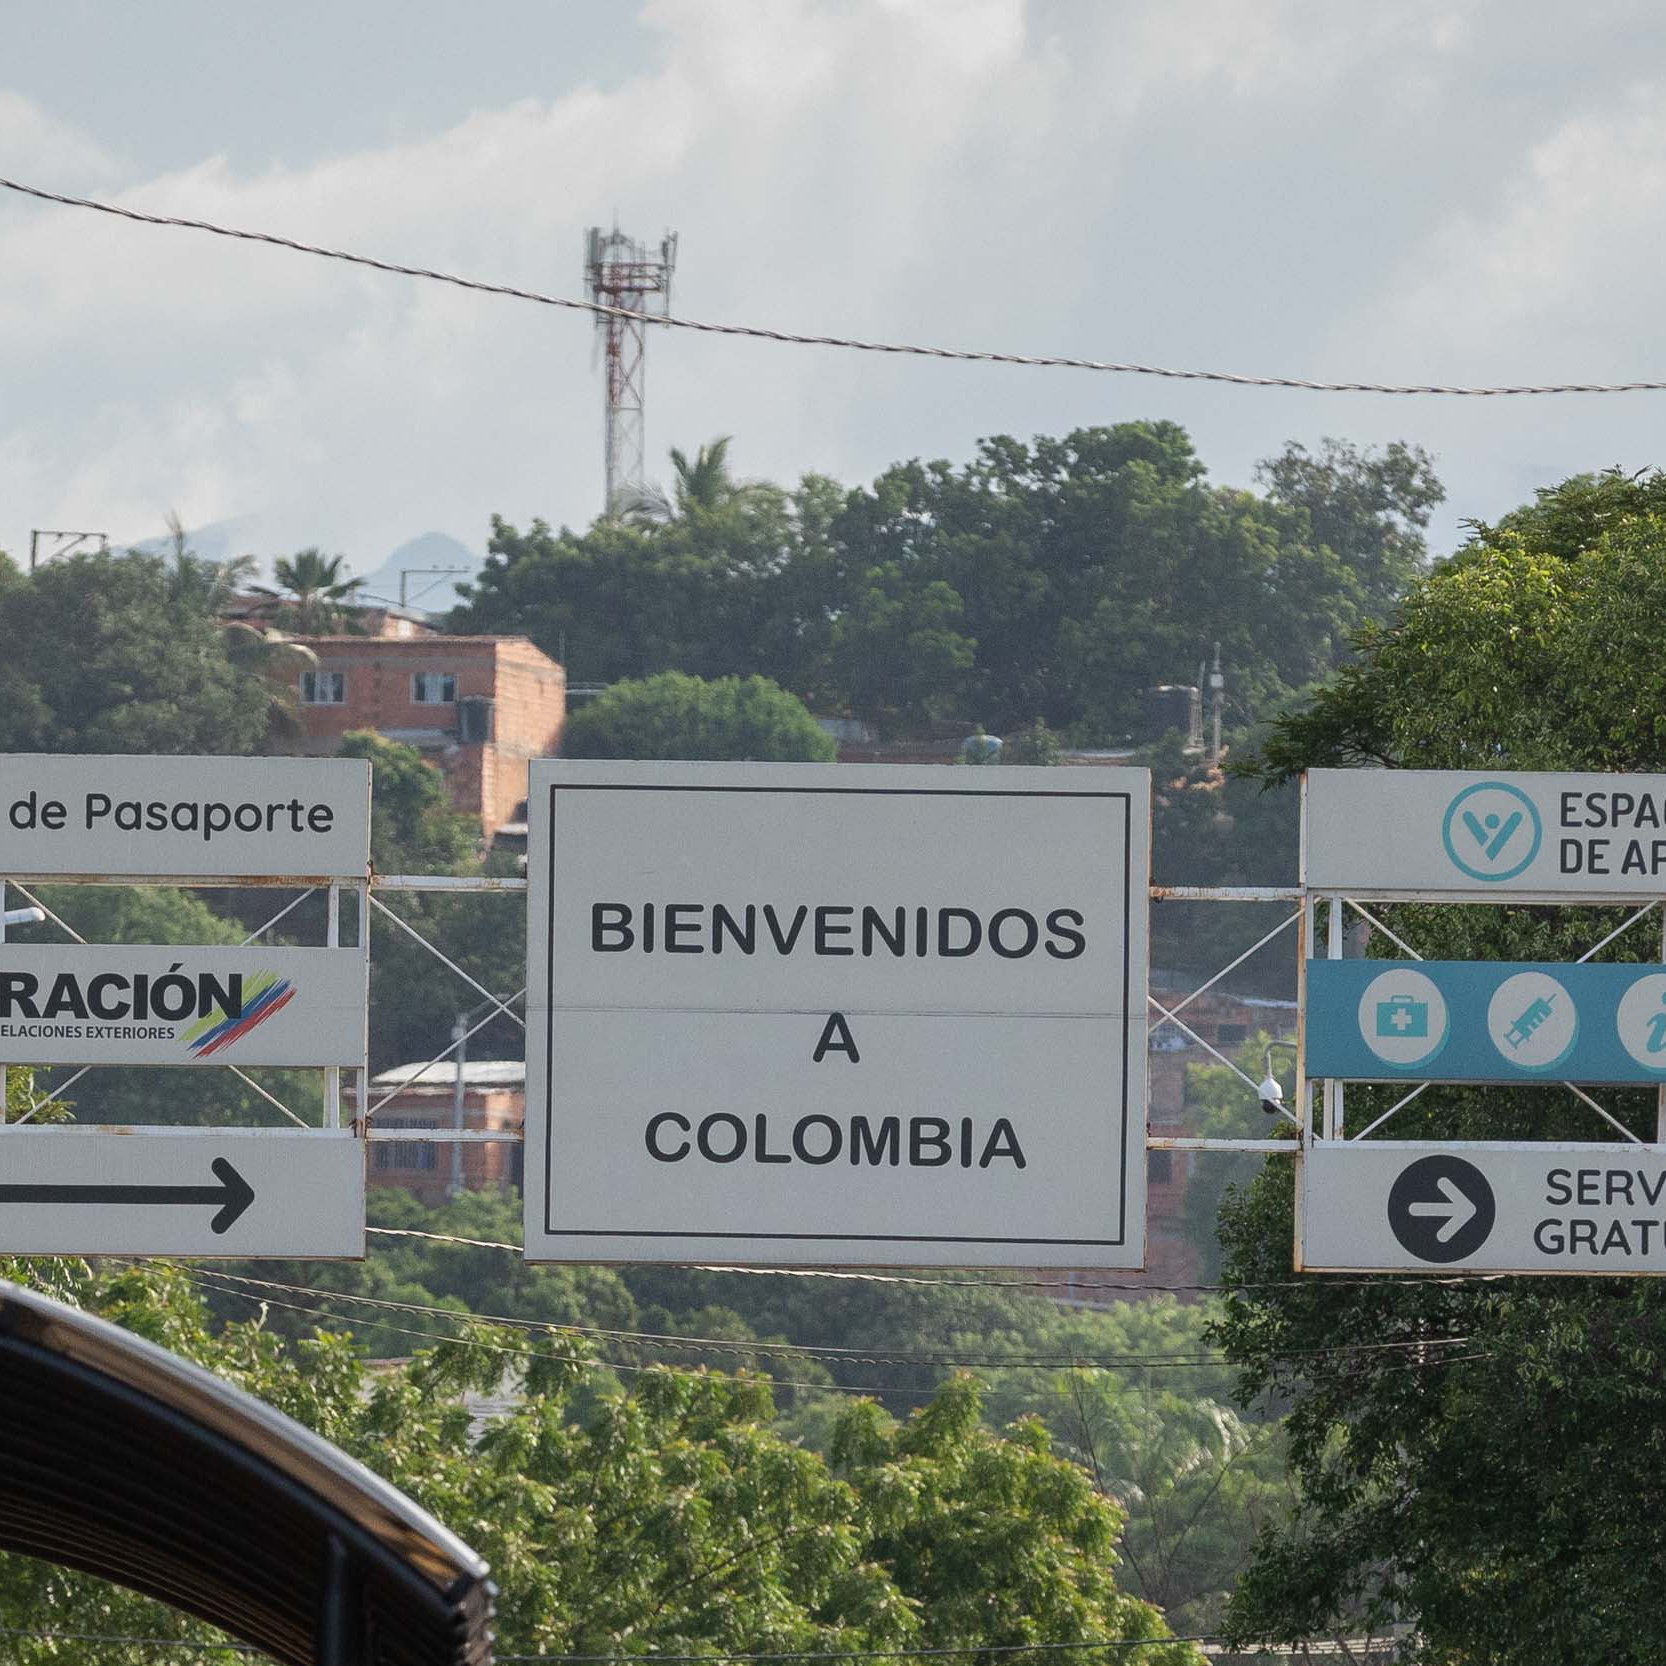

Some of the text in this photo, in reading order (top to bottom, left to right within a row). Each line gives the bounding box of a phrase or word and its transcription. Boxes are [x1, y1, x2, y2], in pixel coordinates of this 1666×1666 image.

[8, 790, 68, 831] de
[85, 792, 334, 842] Pasaporte
[1560, 838, 1611, 875] DE
[591, 902, 1086, 960] BIENVENIDOS
[85, 1025, 175, 1040] EXTERIORES
[812, 1011, 861, 1064] A
[644, 1111, 1027, 1170] COLOMBIA
